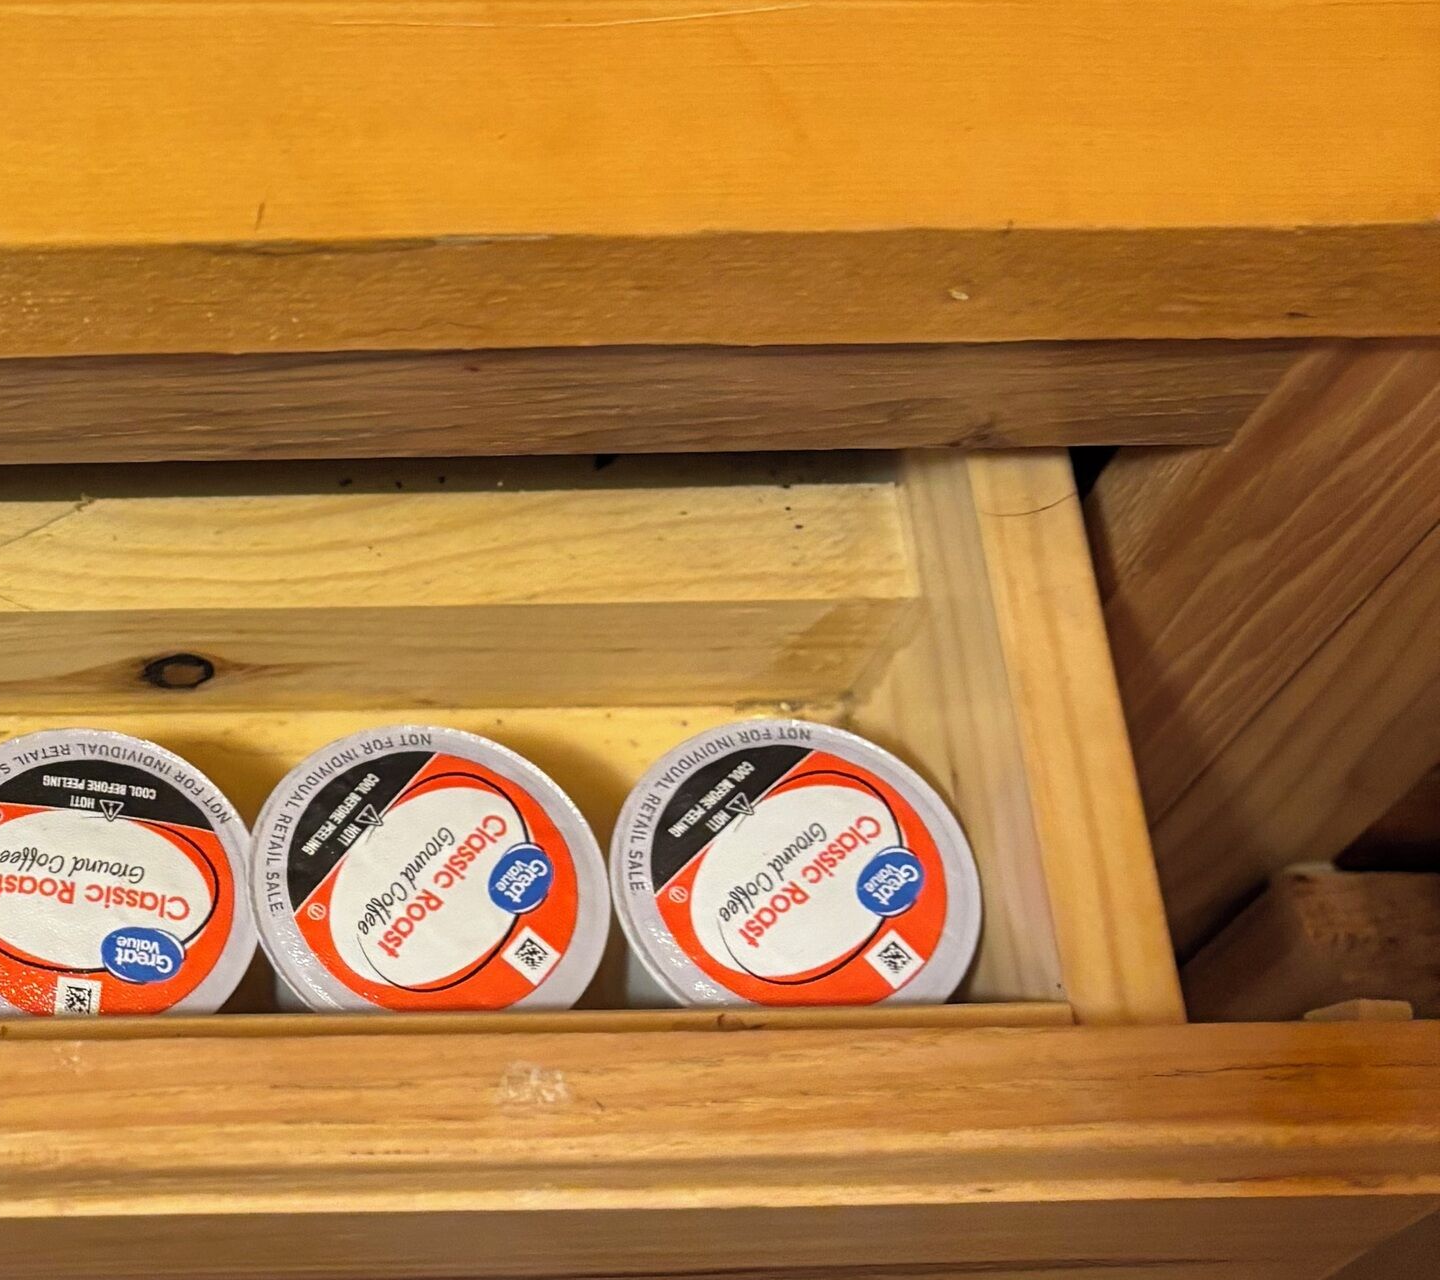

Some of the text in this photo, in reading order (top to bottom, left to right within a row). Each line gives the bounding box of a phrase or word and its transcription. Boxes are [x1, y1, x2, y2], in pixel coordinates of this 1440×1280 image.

[359, 736, 393, 754] FOR
[400, 733, 432, 745] NOT
[738, 728, 771, 744] FOR
[777, 727, 811, 741] NOT
[13, 744, 70, 765] RETAIL
[77, 743, 172, 775] INDIVIDUAL
[656, 736, 733, 788] INDIVIDUAL
[43, 775, 156, 800] COOL BEFORE PEELING
[174, 770, 204, 796] FOR
[284, 749, 359, 808] INDIVIDUAL
[71, 796, 94, 808] HOT!
[202, 795, 232, 825] NOT
[301, 772, 380, 855] COOL BEFORE PEELING
[668, 761, 755, 838] COOL BEFORE PEELING
[630, 792, 661, 844] RETAIL
[706, 811, 731, 831] HOT!
[266, 813, 292, 865] RETAIL
[336, 823, 360, 845] HOT!
[71, 857, 145, 883] Ground
[357, 827, 456, 935] Ground Coffee
[495, 860, 529, 891] Value
[504, 860, 548, 903] Great
[719, 822, 827, 923] Ground Coffee
[738, 815, 881, 948] Classic Roast
[872, 864, 919, 906] Great
[377, 815, 507, 958] Classic Roast
[85, 885, 190, 920] Classic
[116, 936, 160, 952] Value
[115, 948, 173, 973] Great
